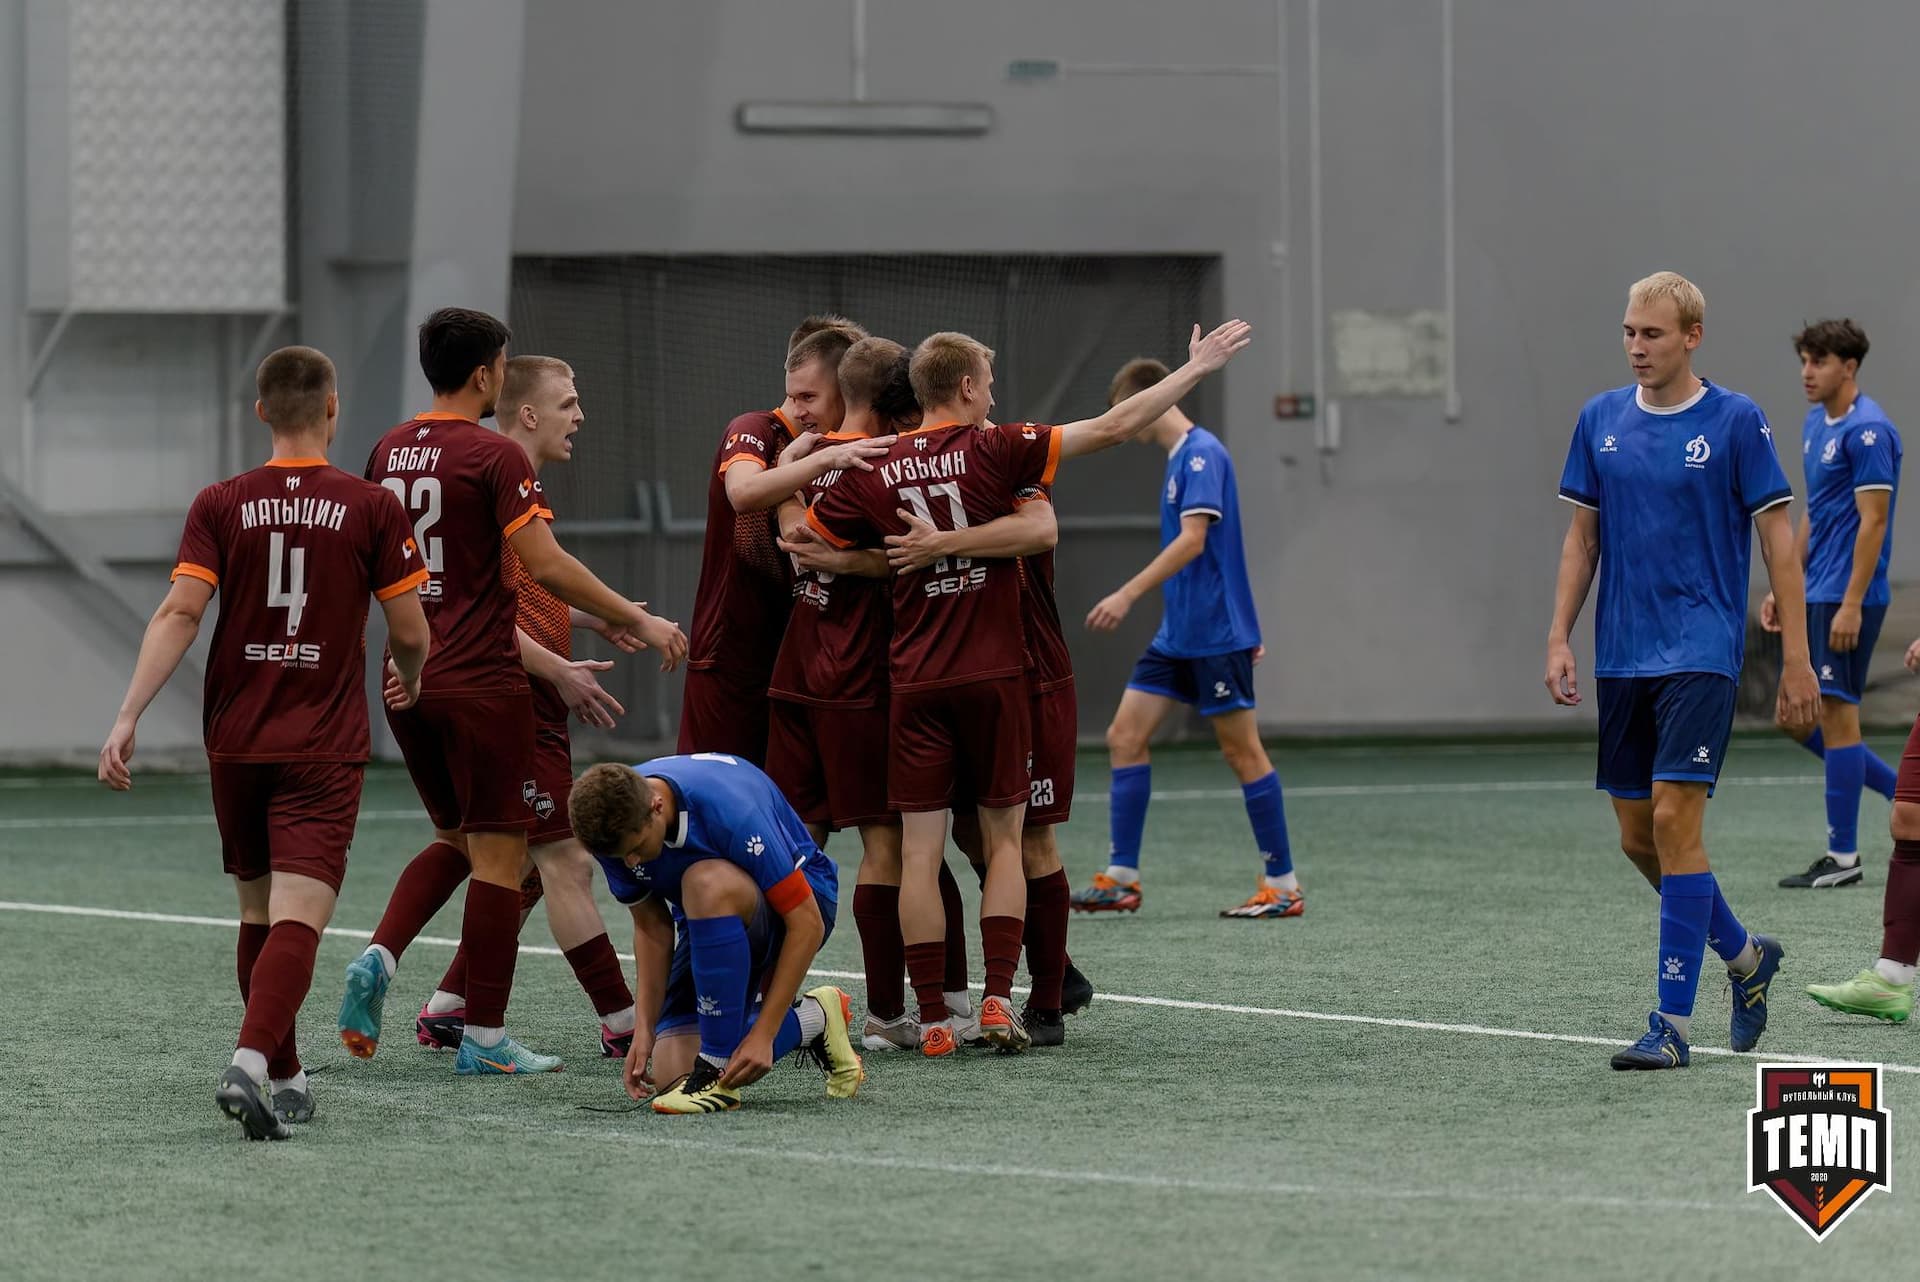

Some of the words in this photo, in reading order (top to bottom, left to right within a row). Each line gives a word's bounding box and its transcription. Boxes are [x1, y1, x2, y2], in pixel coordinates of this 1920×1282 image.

[387, 447, 442, 472] БАБИЧ
[880, 450, 966, 488] КУЗЬКИН
[241, 498, 347, 531] МАТЫЦИН
[898, 481, 972, 573] 17
[267, 532, 308, 636] 4
[416, 580, 443, 596] US
[245, 643, 321, 661] SEUS
[1030, 778, 1054, 807] 23
